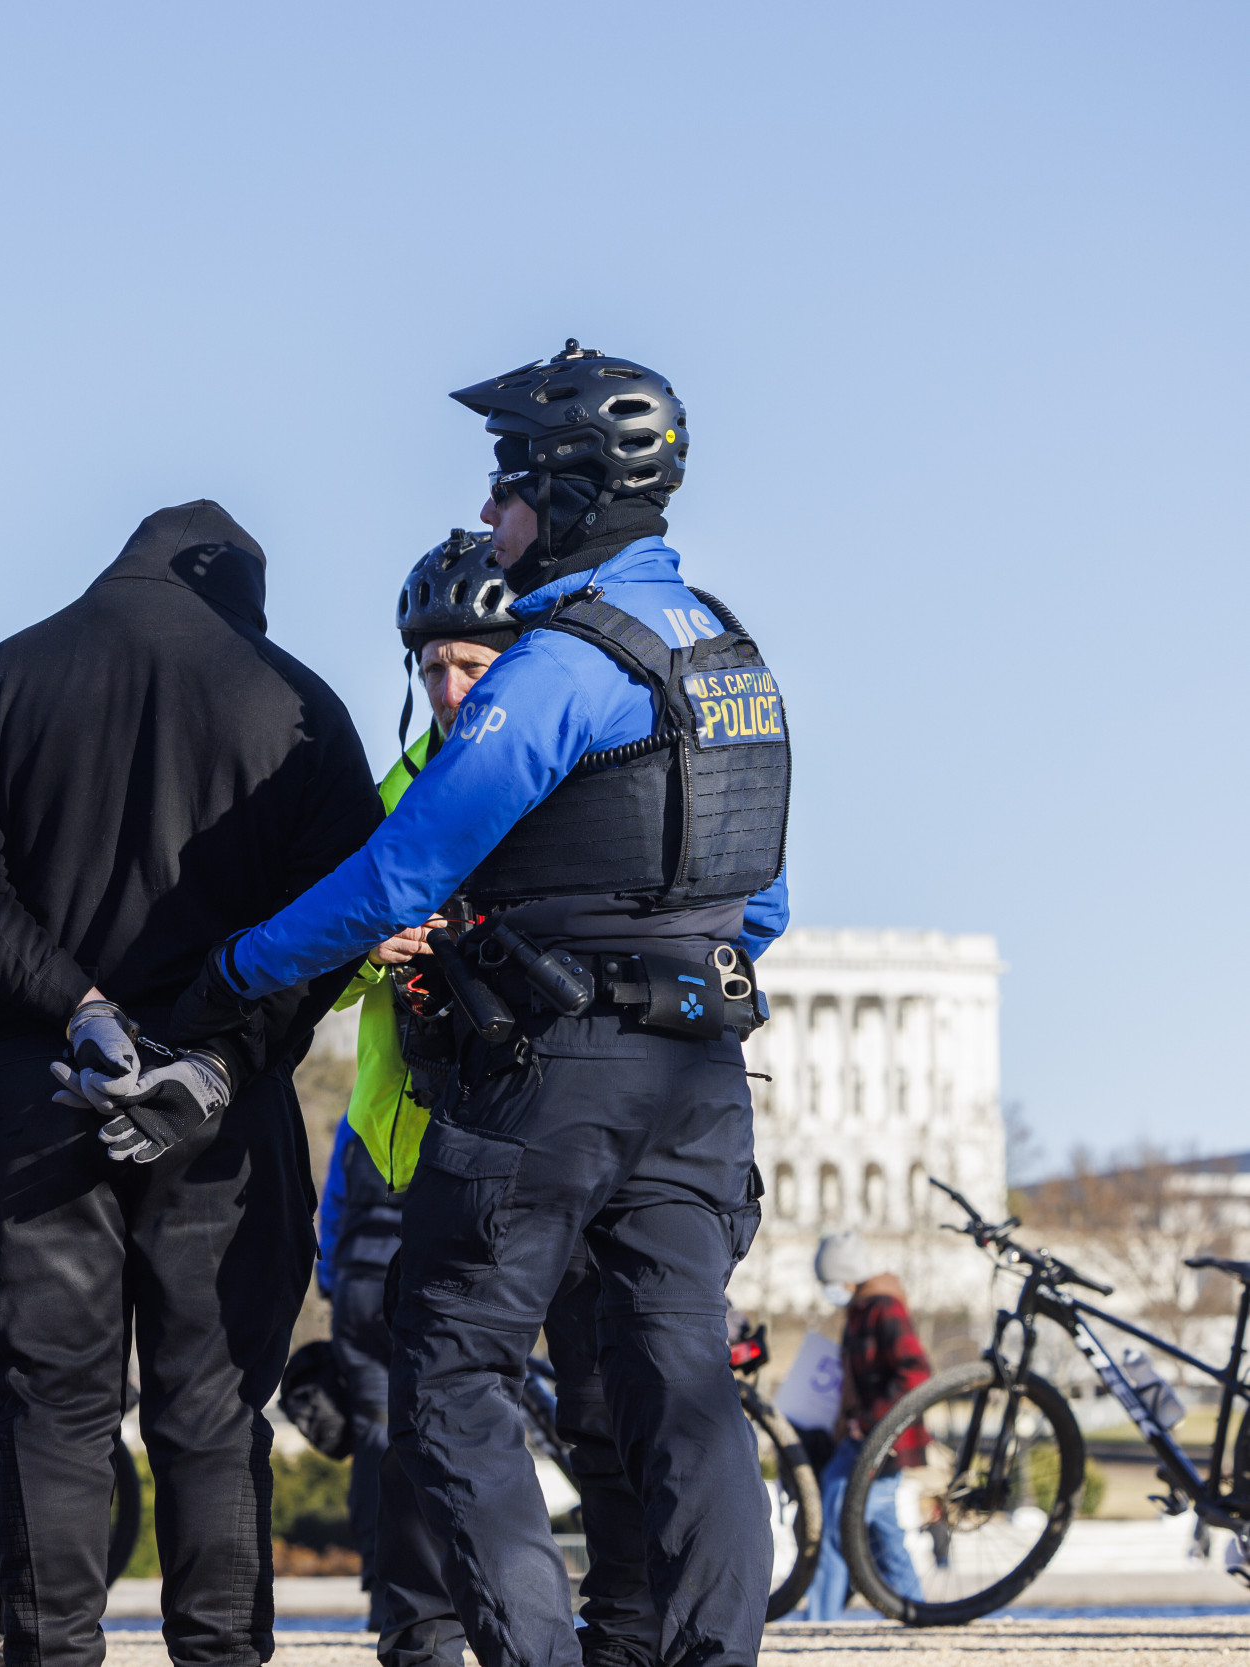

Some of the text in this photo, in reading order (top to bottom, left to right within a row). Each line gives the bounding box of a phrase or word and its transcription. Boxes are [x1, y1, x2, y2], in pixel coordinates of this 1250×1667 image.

[693, 672, 777, 699] U.S. CAPITOL
[702, 696, 781, 739] POLICE
